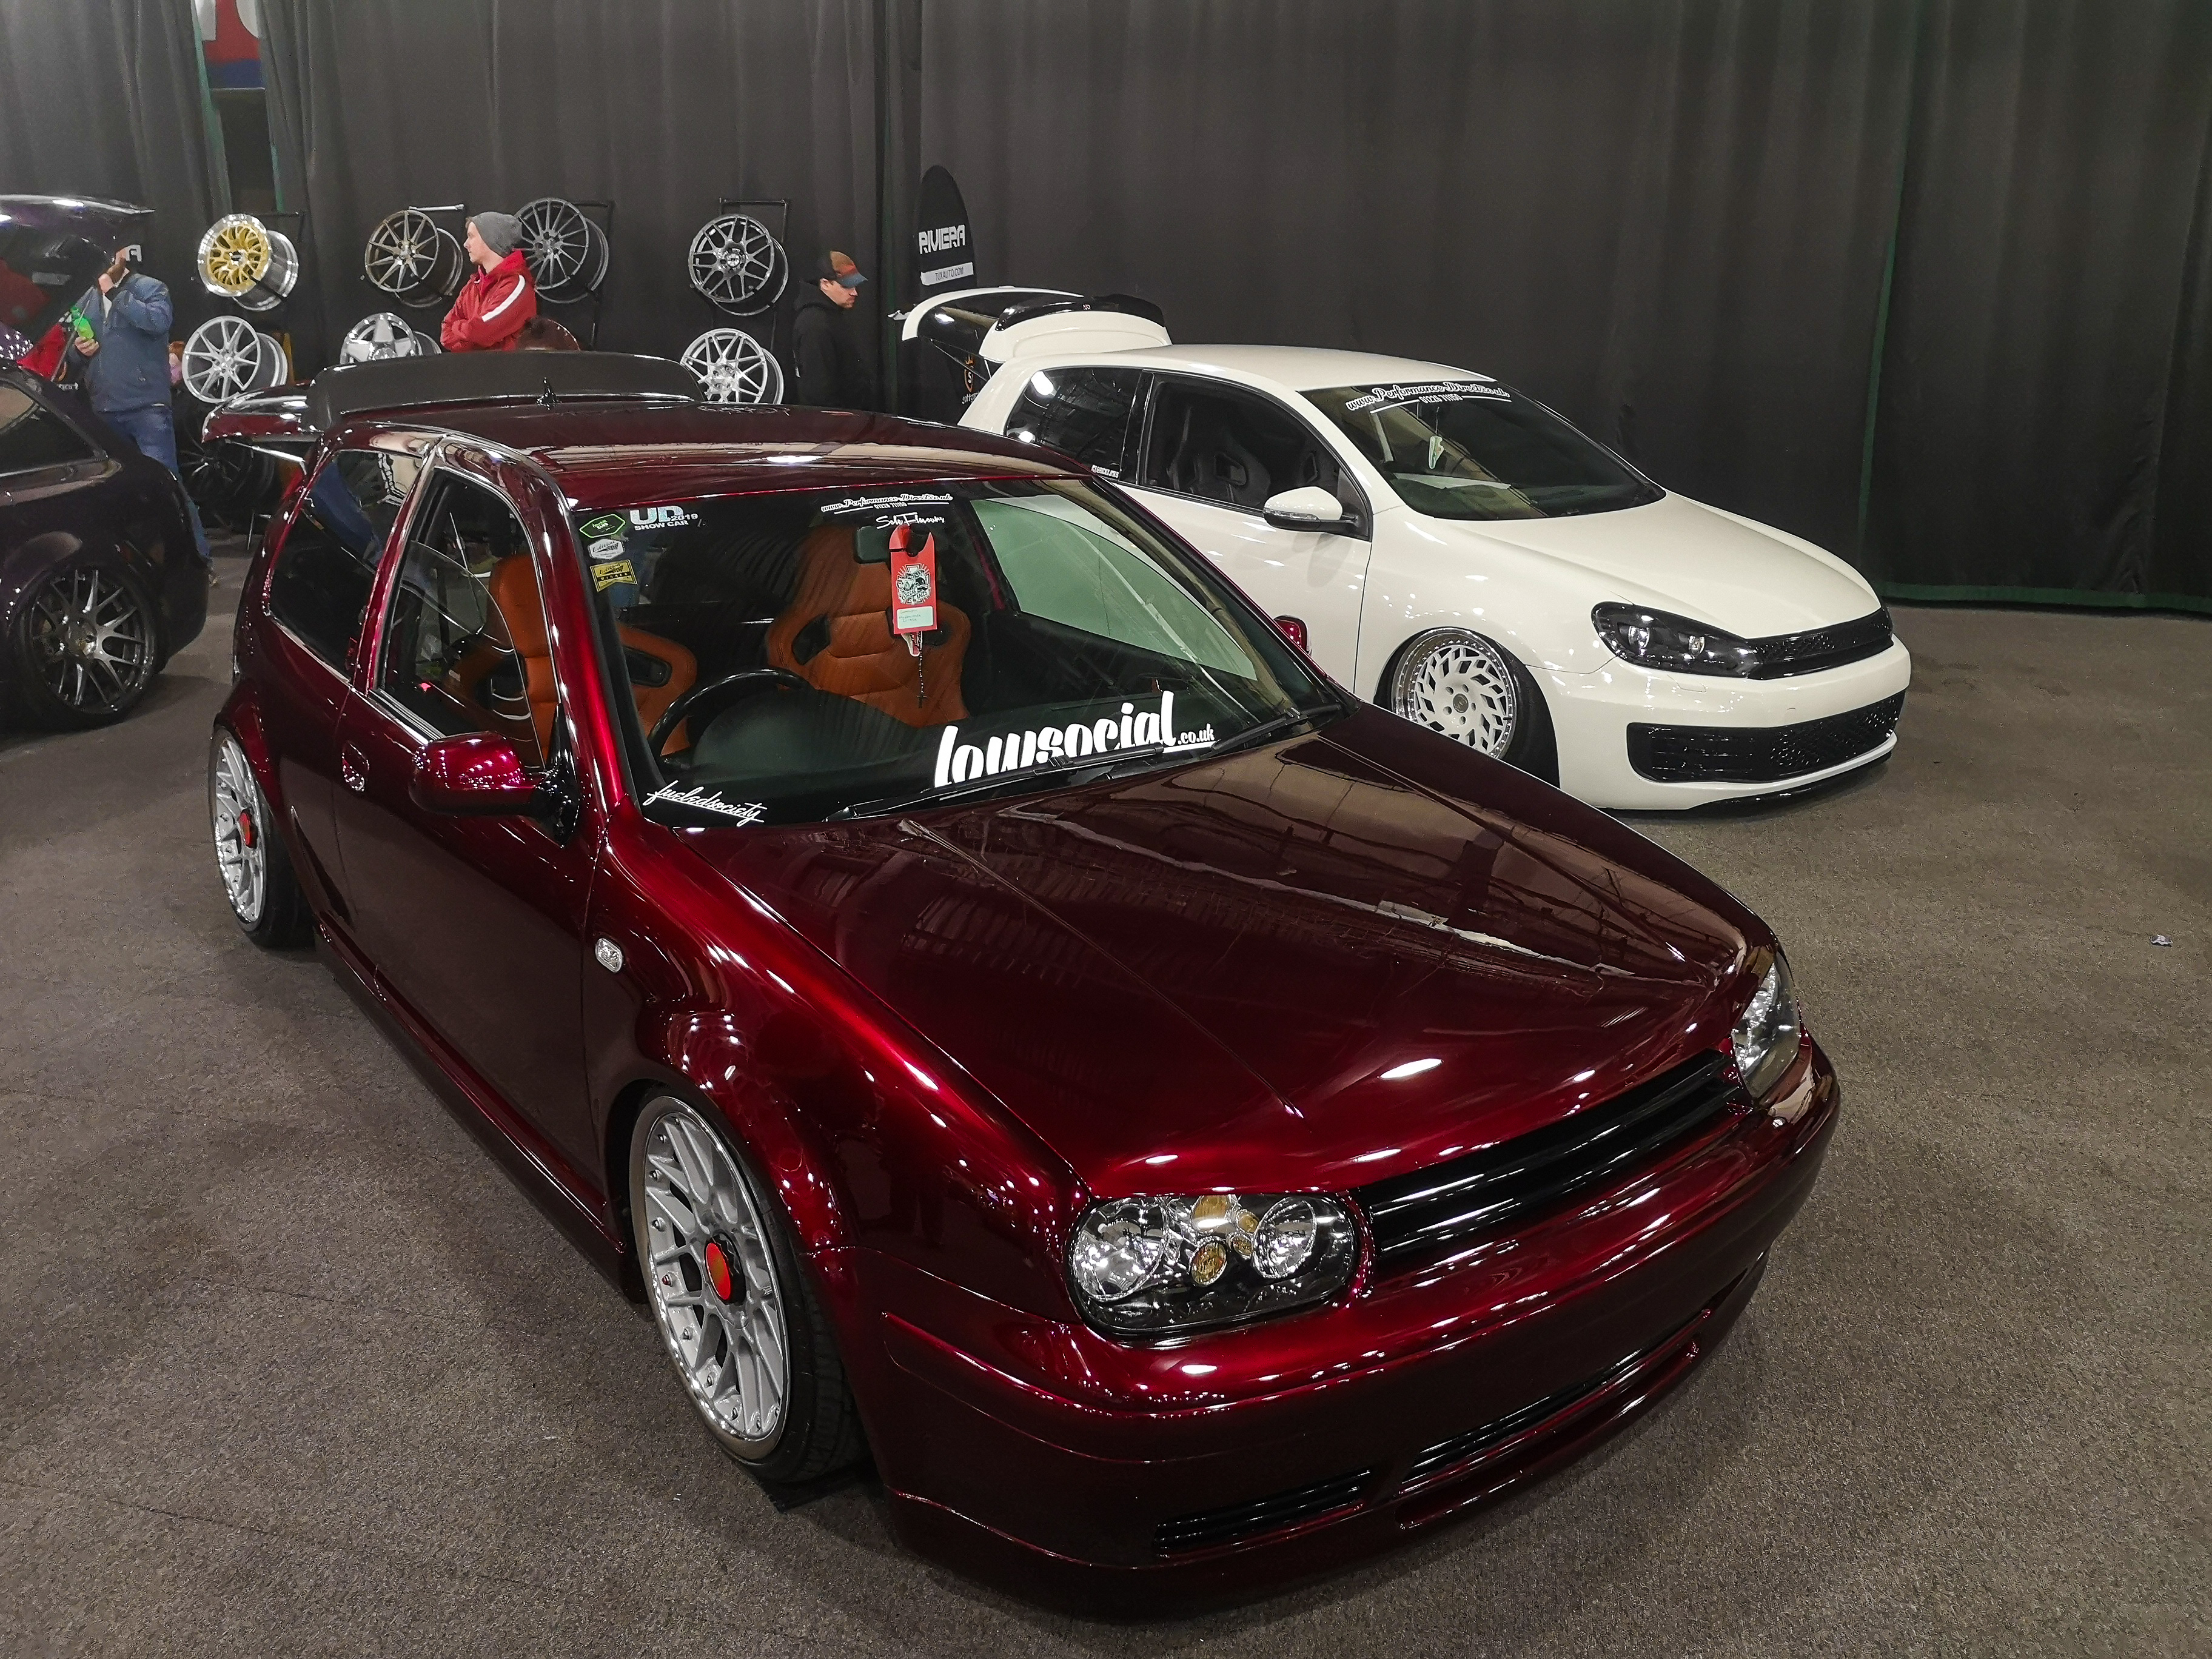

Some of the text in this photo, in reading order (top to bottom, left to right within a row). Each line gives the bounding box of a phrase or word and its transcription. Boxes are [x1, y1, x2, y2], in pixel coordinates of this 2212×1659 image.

[919, 224, 965, 254] RIVIERA
[629, 505, 684, 525] UD
[670, 513, 699, 521] 2019
[634, 522, 665, 531] SHOW
